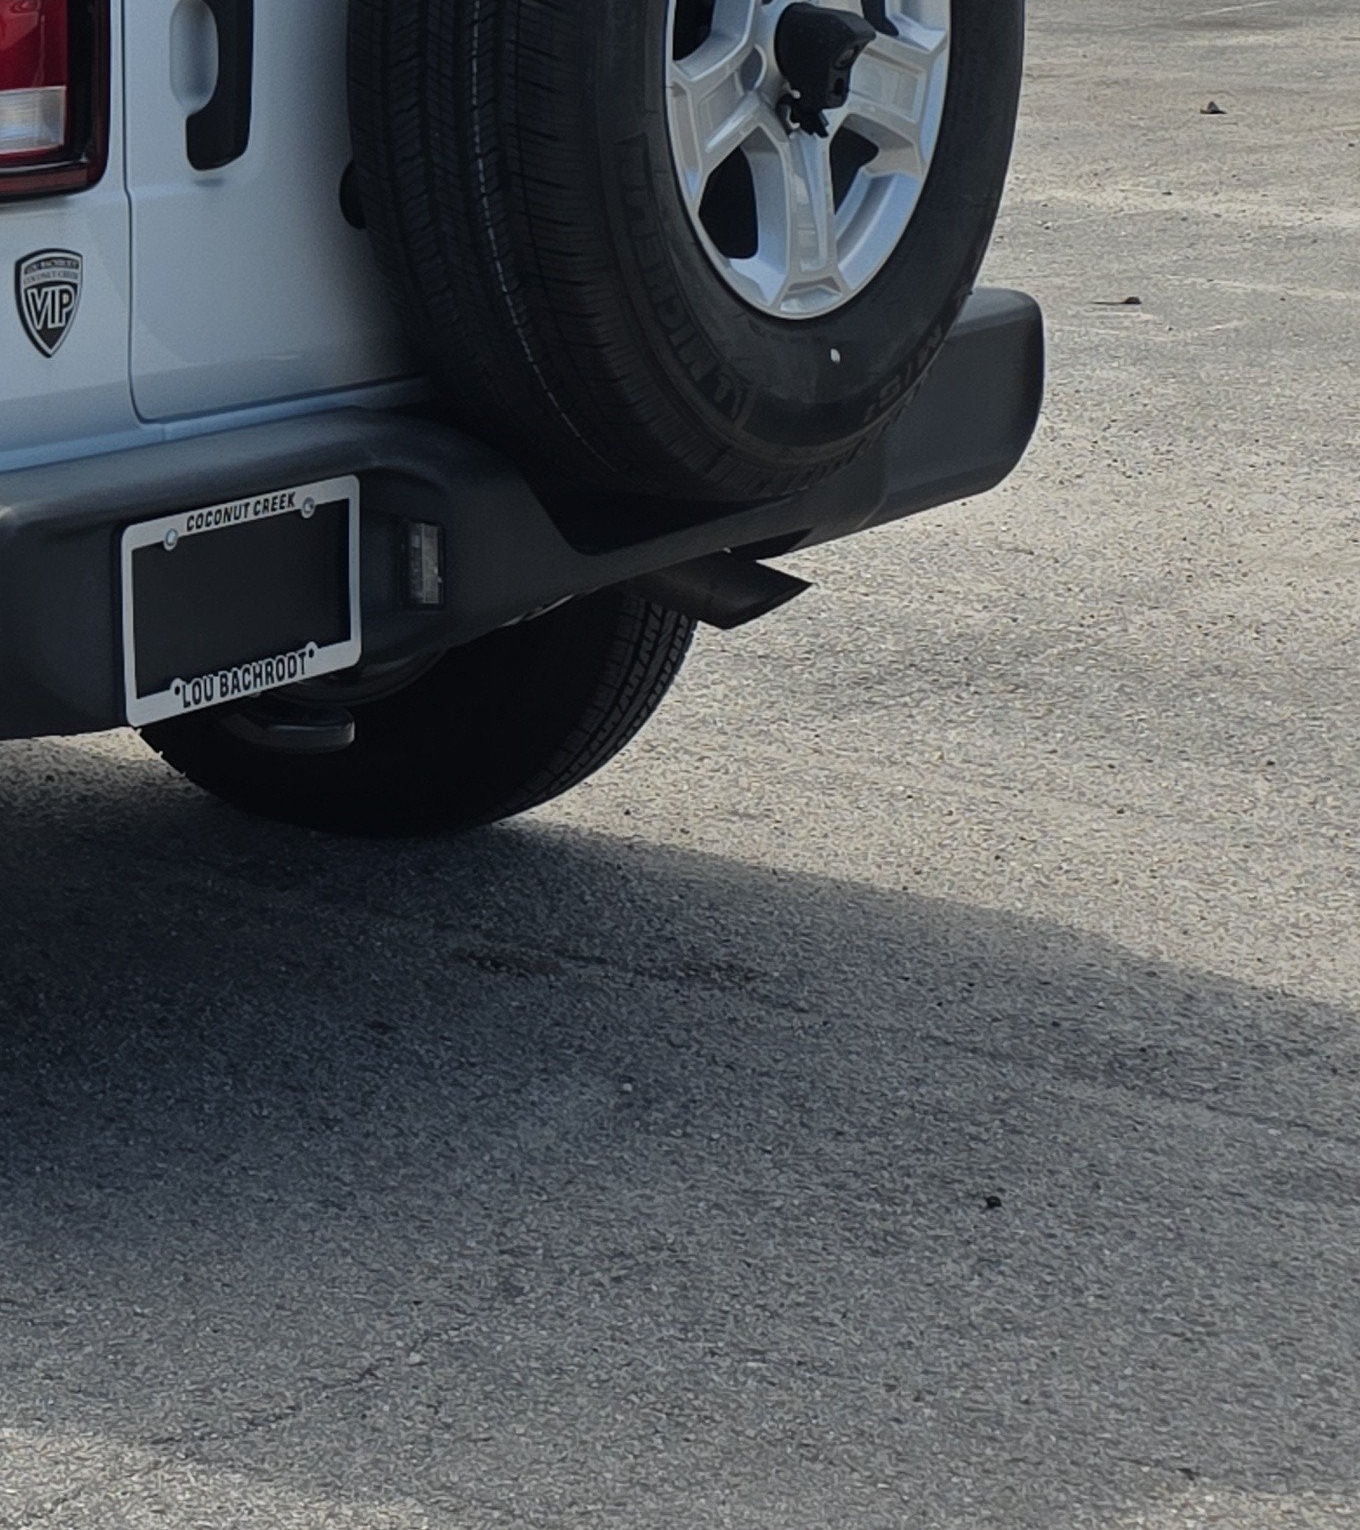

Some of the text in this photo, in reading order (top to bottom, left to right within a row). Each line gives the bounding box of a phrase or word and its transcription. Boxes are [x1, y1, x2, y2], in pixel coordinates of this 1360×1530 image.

[27, 284, 75, 330] VIP
[186, 491, 296, 533] COCONUT CREEK
[182, 651, 307, 709] LOU BACHRODT
